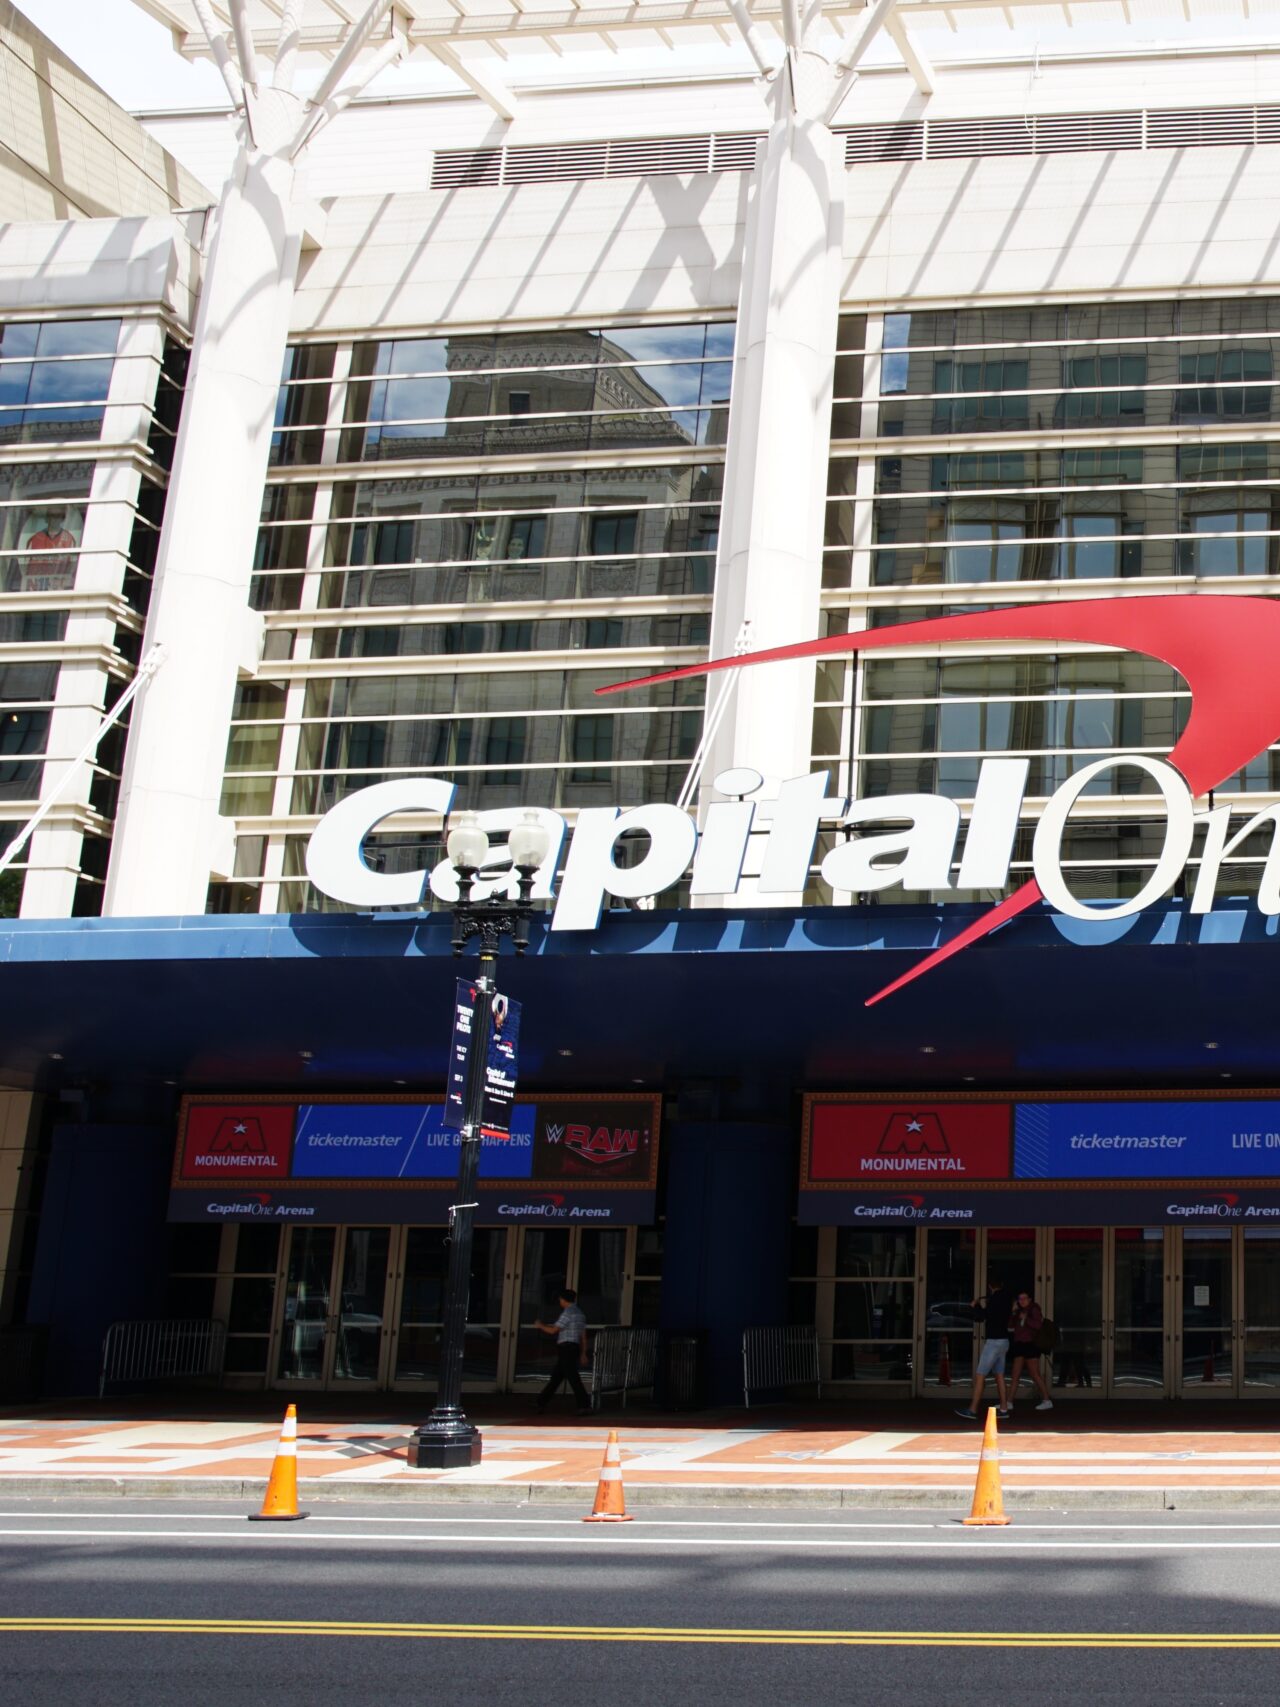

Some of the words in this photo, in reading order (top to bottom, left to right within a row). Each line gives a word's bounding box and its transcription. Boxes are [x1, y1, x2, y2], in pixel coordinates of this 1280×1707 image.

[308, 1133, 402, 1147] ticketmaster
[427, 1133, 451, 1147] LIVE
[565, 1123, 640, 1153] RAW
[1070, 1134, 1187, 1149] ticketmaster
[1232, 1133, 1262, 1148] LIVE
[194, 1155, 278, 1167] MONUMENTAL
[860, 1158, 966, 1171] MONUMENTAL
[275, 1205, 315, 1216] Arena
[569, 1206, 611, 1217] Arena
[929, 1207, 973, 1218] Arena
